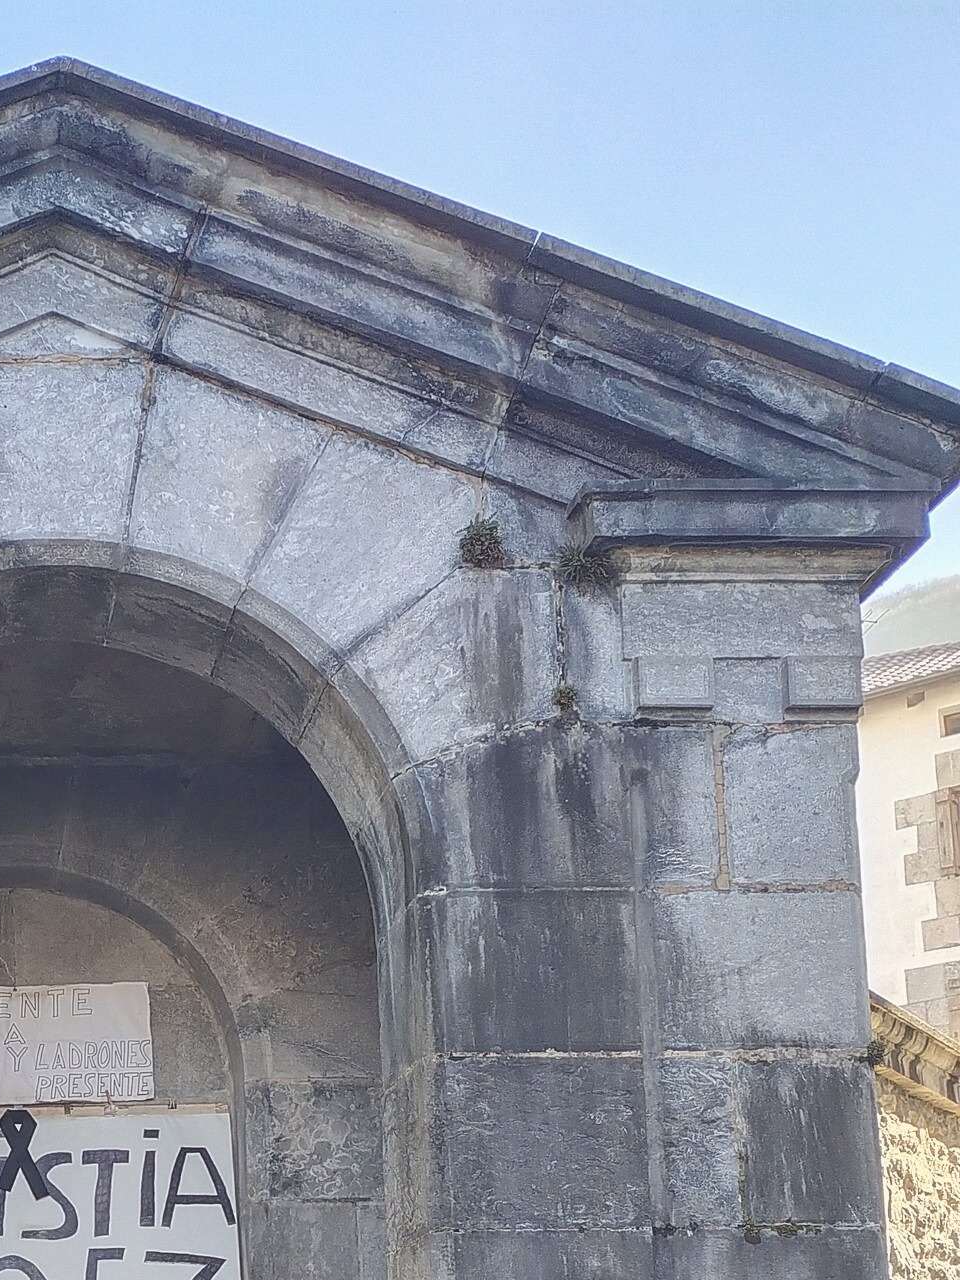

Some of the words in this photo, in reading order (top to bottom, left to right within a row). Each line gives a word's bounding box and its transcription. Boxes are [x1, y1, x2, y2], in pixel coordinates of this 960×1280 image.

[3, 1023, 26, 1045] A
[6, 1046, 28, 1072] Y
[34, 1039, 152, 1071] LADRONES
[35, 1072, 154, 1100] PRESENTE
